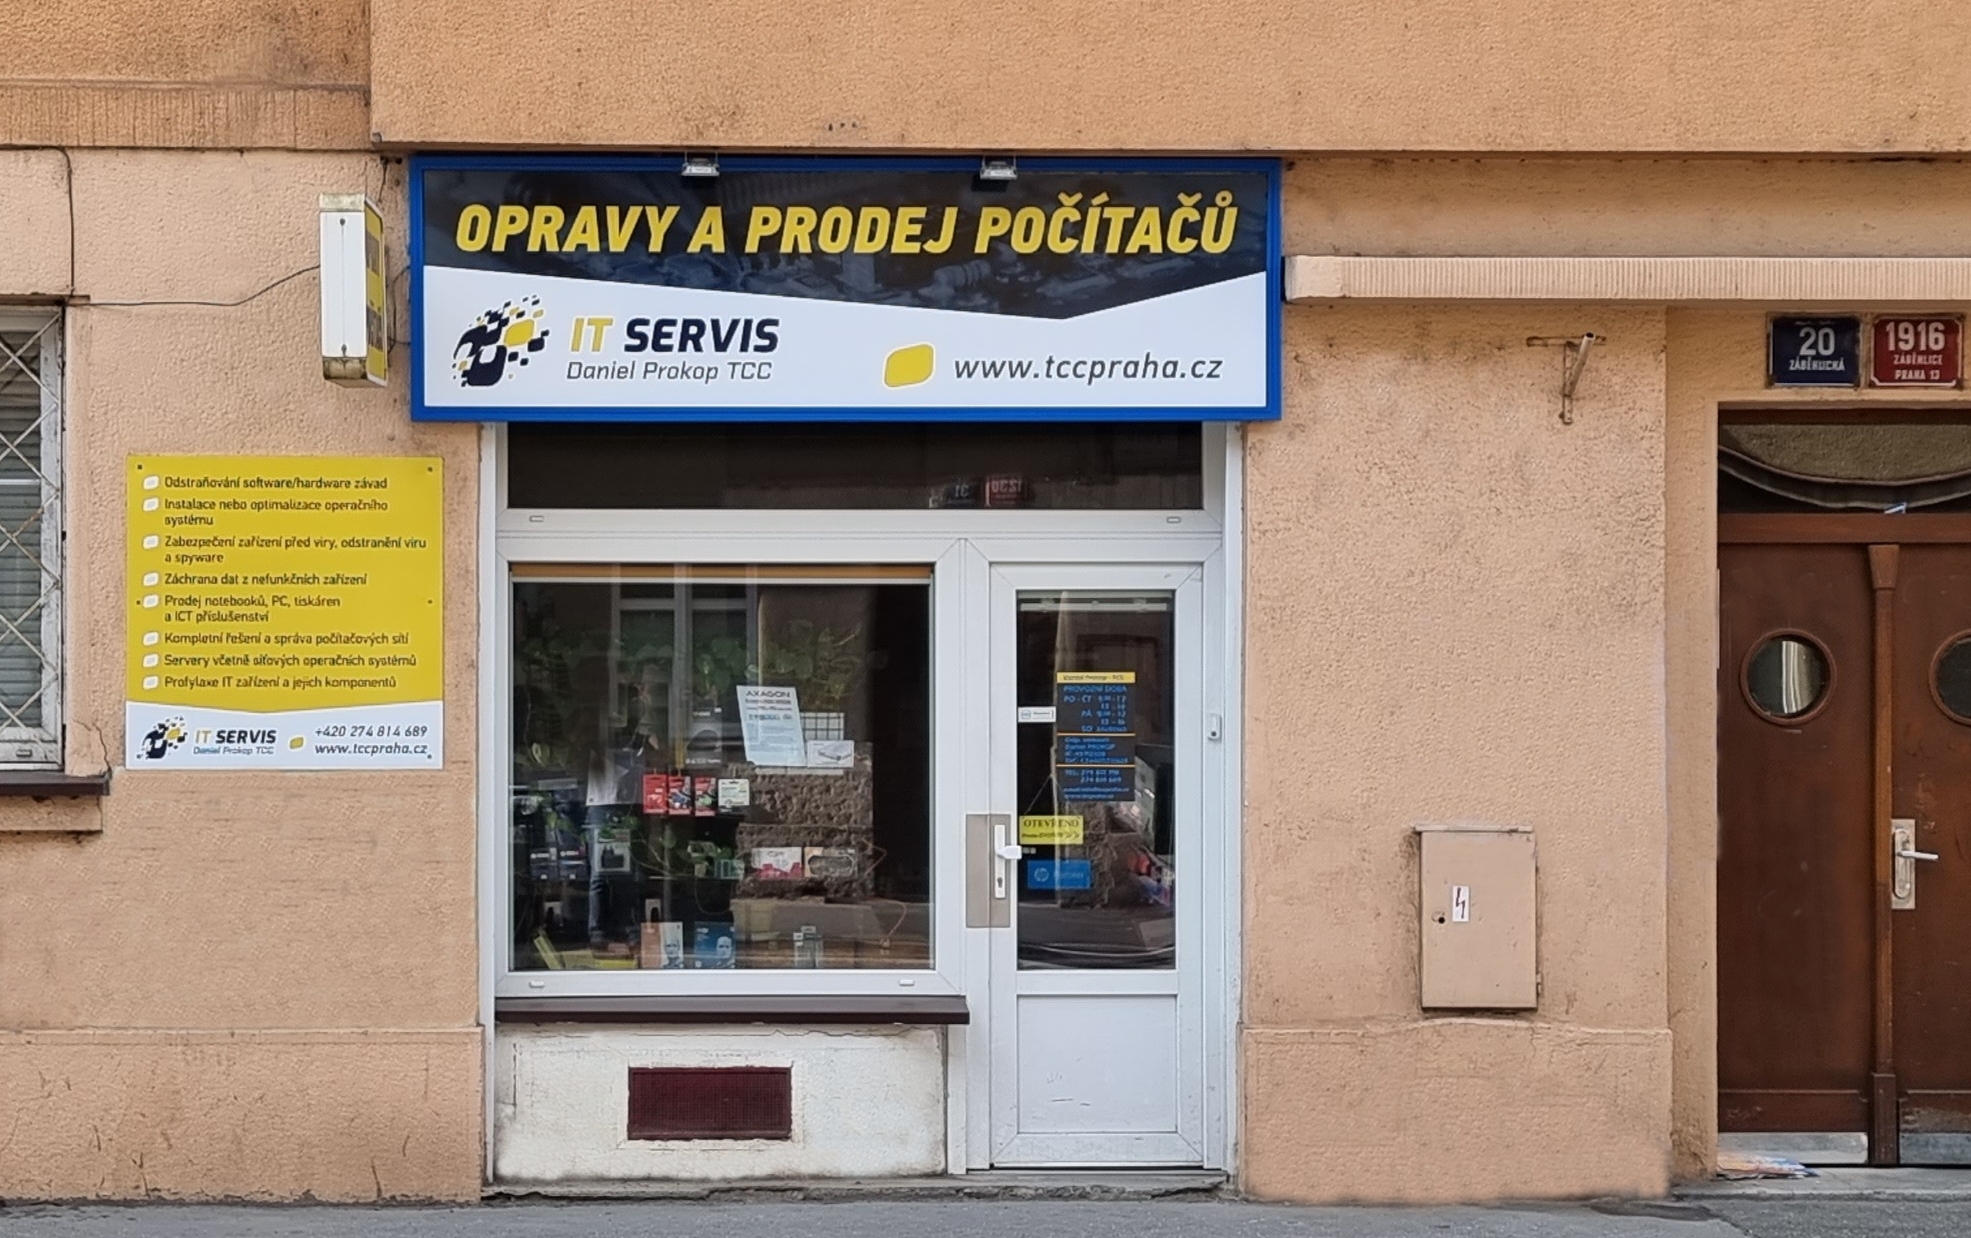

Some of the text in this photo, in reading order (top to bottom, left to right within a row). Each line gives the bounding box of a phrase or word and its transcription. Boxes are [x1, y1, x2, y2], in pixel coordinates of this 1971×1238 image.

[455, 190, 1239, 254] OPRAVY A PRODEJ POČÍTAČŮ
[569, 317, 780, 353] IT SERVIS
[1799, 326, 1836, 356] 20
[1886, 321, 1945, 351] 1916
[566, 361, 773, 384] Daniel Prokop TCC
[954, 352, 1223, 386] www.tccpraha.cz
[1895, 369, 1926, 380] PRAHA
[165, 476, 388, 489] Odstraňování software/hardware závad
[165, 498, 388, 513] Instalace nebo optimalizace operačního
[165, 515, 214, 528] systému
[165, 535, 236, 550] Zabezpečení
[238, 536, 282, 548] zařízení
[285, 536, 311, 550] před
[341, 537, 401, 549] odstranění
[404, 537, 427, 549] viru
[165, 553, 224, 566] a spyware
[164, 573, 368, 585] Záchrana dat z nefunkčních zařízení
[165, 594, 341, 609] Prodej notebooků, PC, tiskáren
[165, 610, 269, 624] a ICT příslušenství
[165, 632, 410, 647] Kompletní řešení a správa počítačových sítí
[164, 653, 417, 669] Servery včetně síťových operačních systémů
[165, 675, 397, 690] Profylaxe IT zařízení a jejich komponentů
[746, 690, 790, 698] AXAGON
[195, 730, 277, 744] IT SERVIS
[315, 725, 428, 737] +420 274 814 689
[193, 746, 221, 755] Daniel
[315, 742, 428, 757] www.tccpraha.cz
